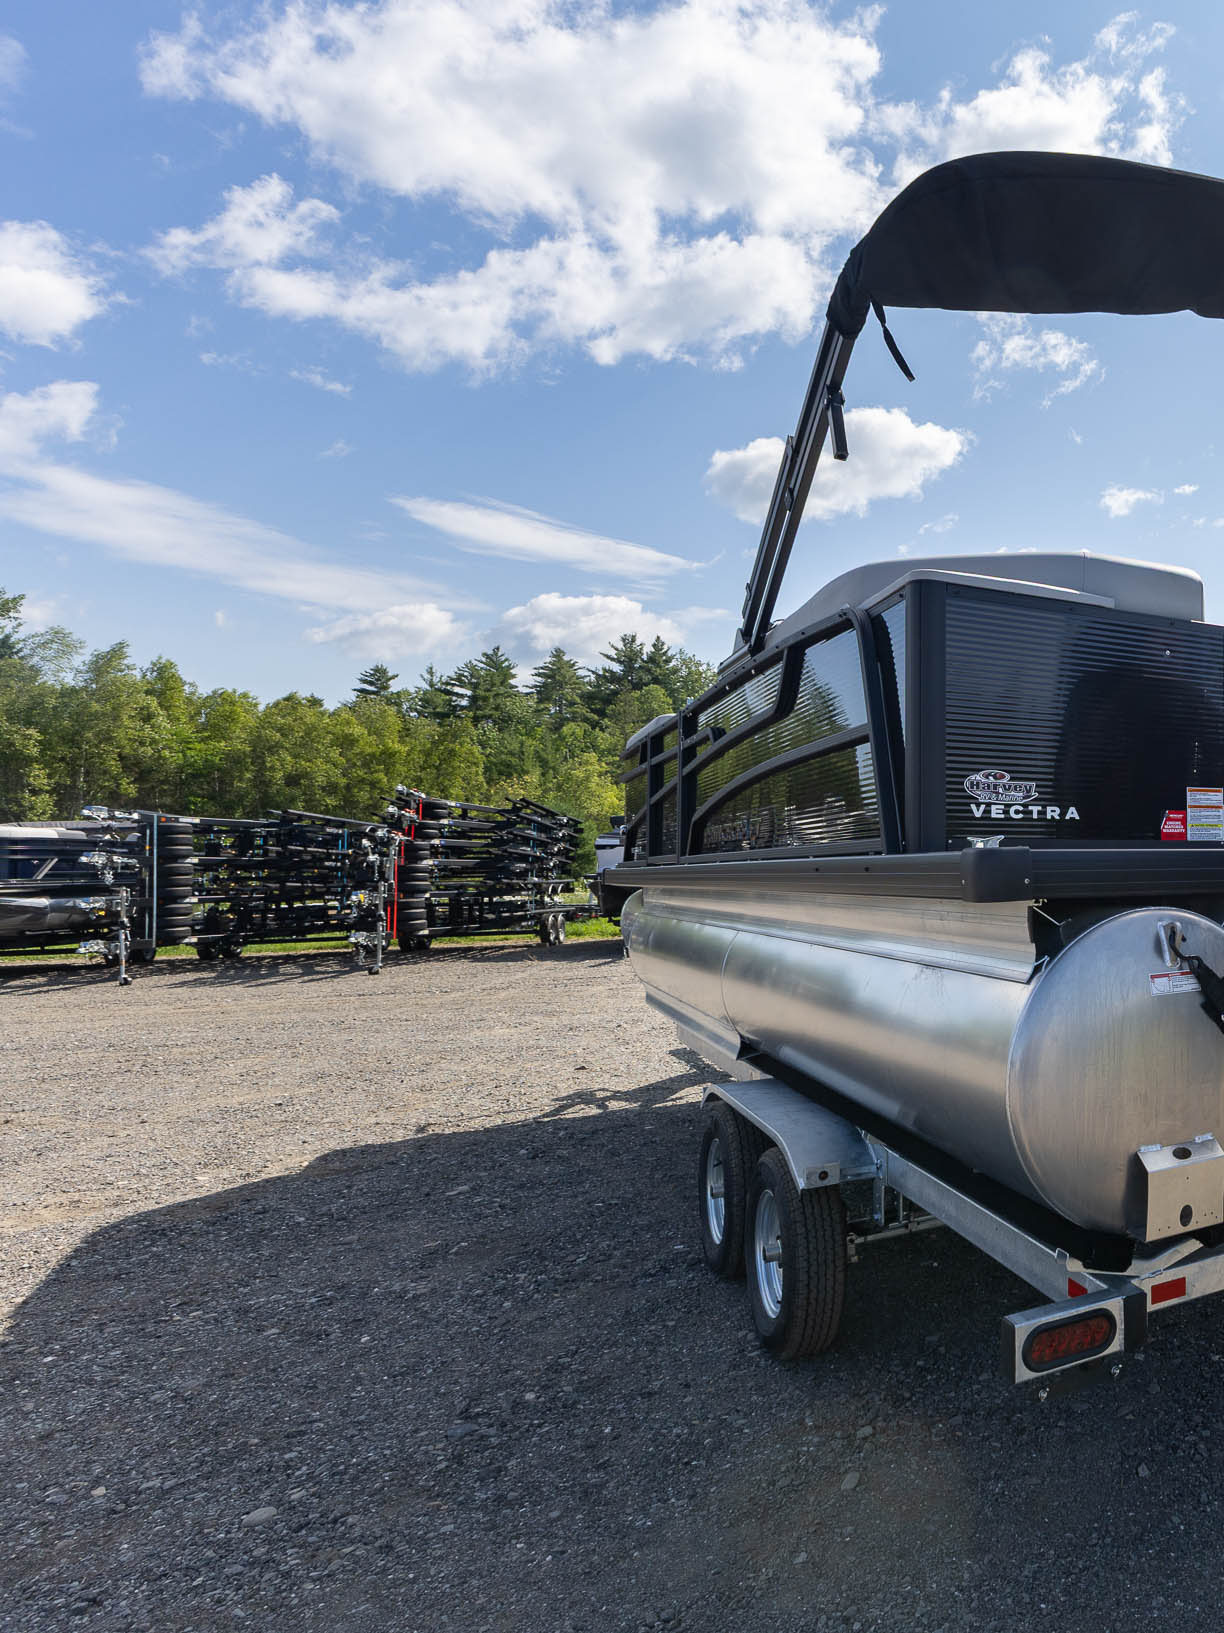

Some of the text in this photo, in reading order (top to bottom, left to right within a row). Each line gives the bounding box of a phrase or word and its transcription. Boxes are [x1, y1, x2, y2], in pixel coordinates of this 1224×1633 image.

[967, 779, 1034, 796] Harvey
[980, 793, 990, 801] RV
[999, 794, 1024, 802] Marine
[970, 803, 1080, 820] VECTRA
